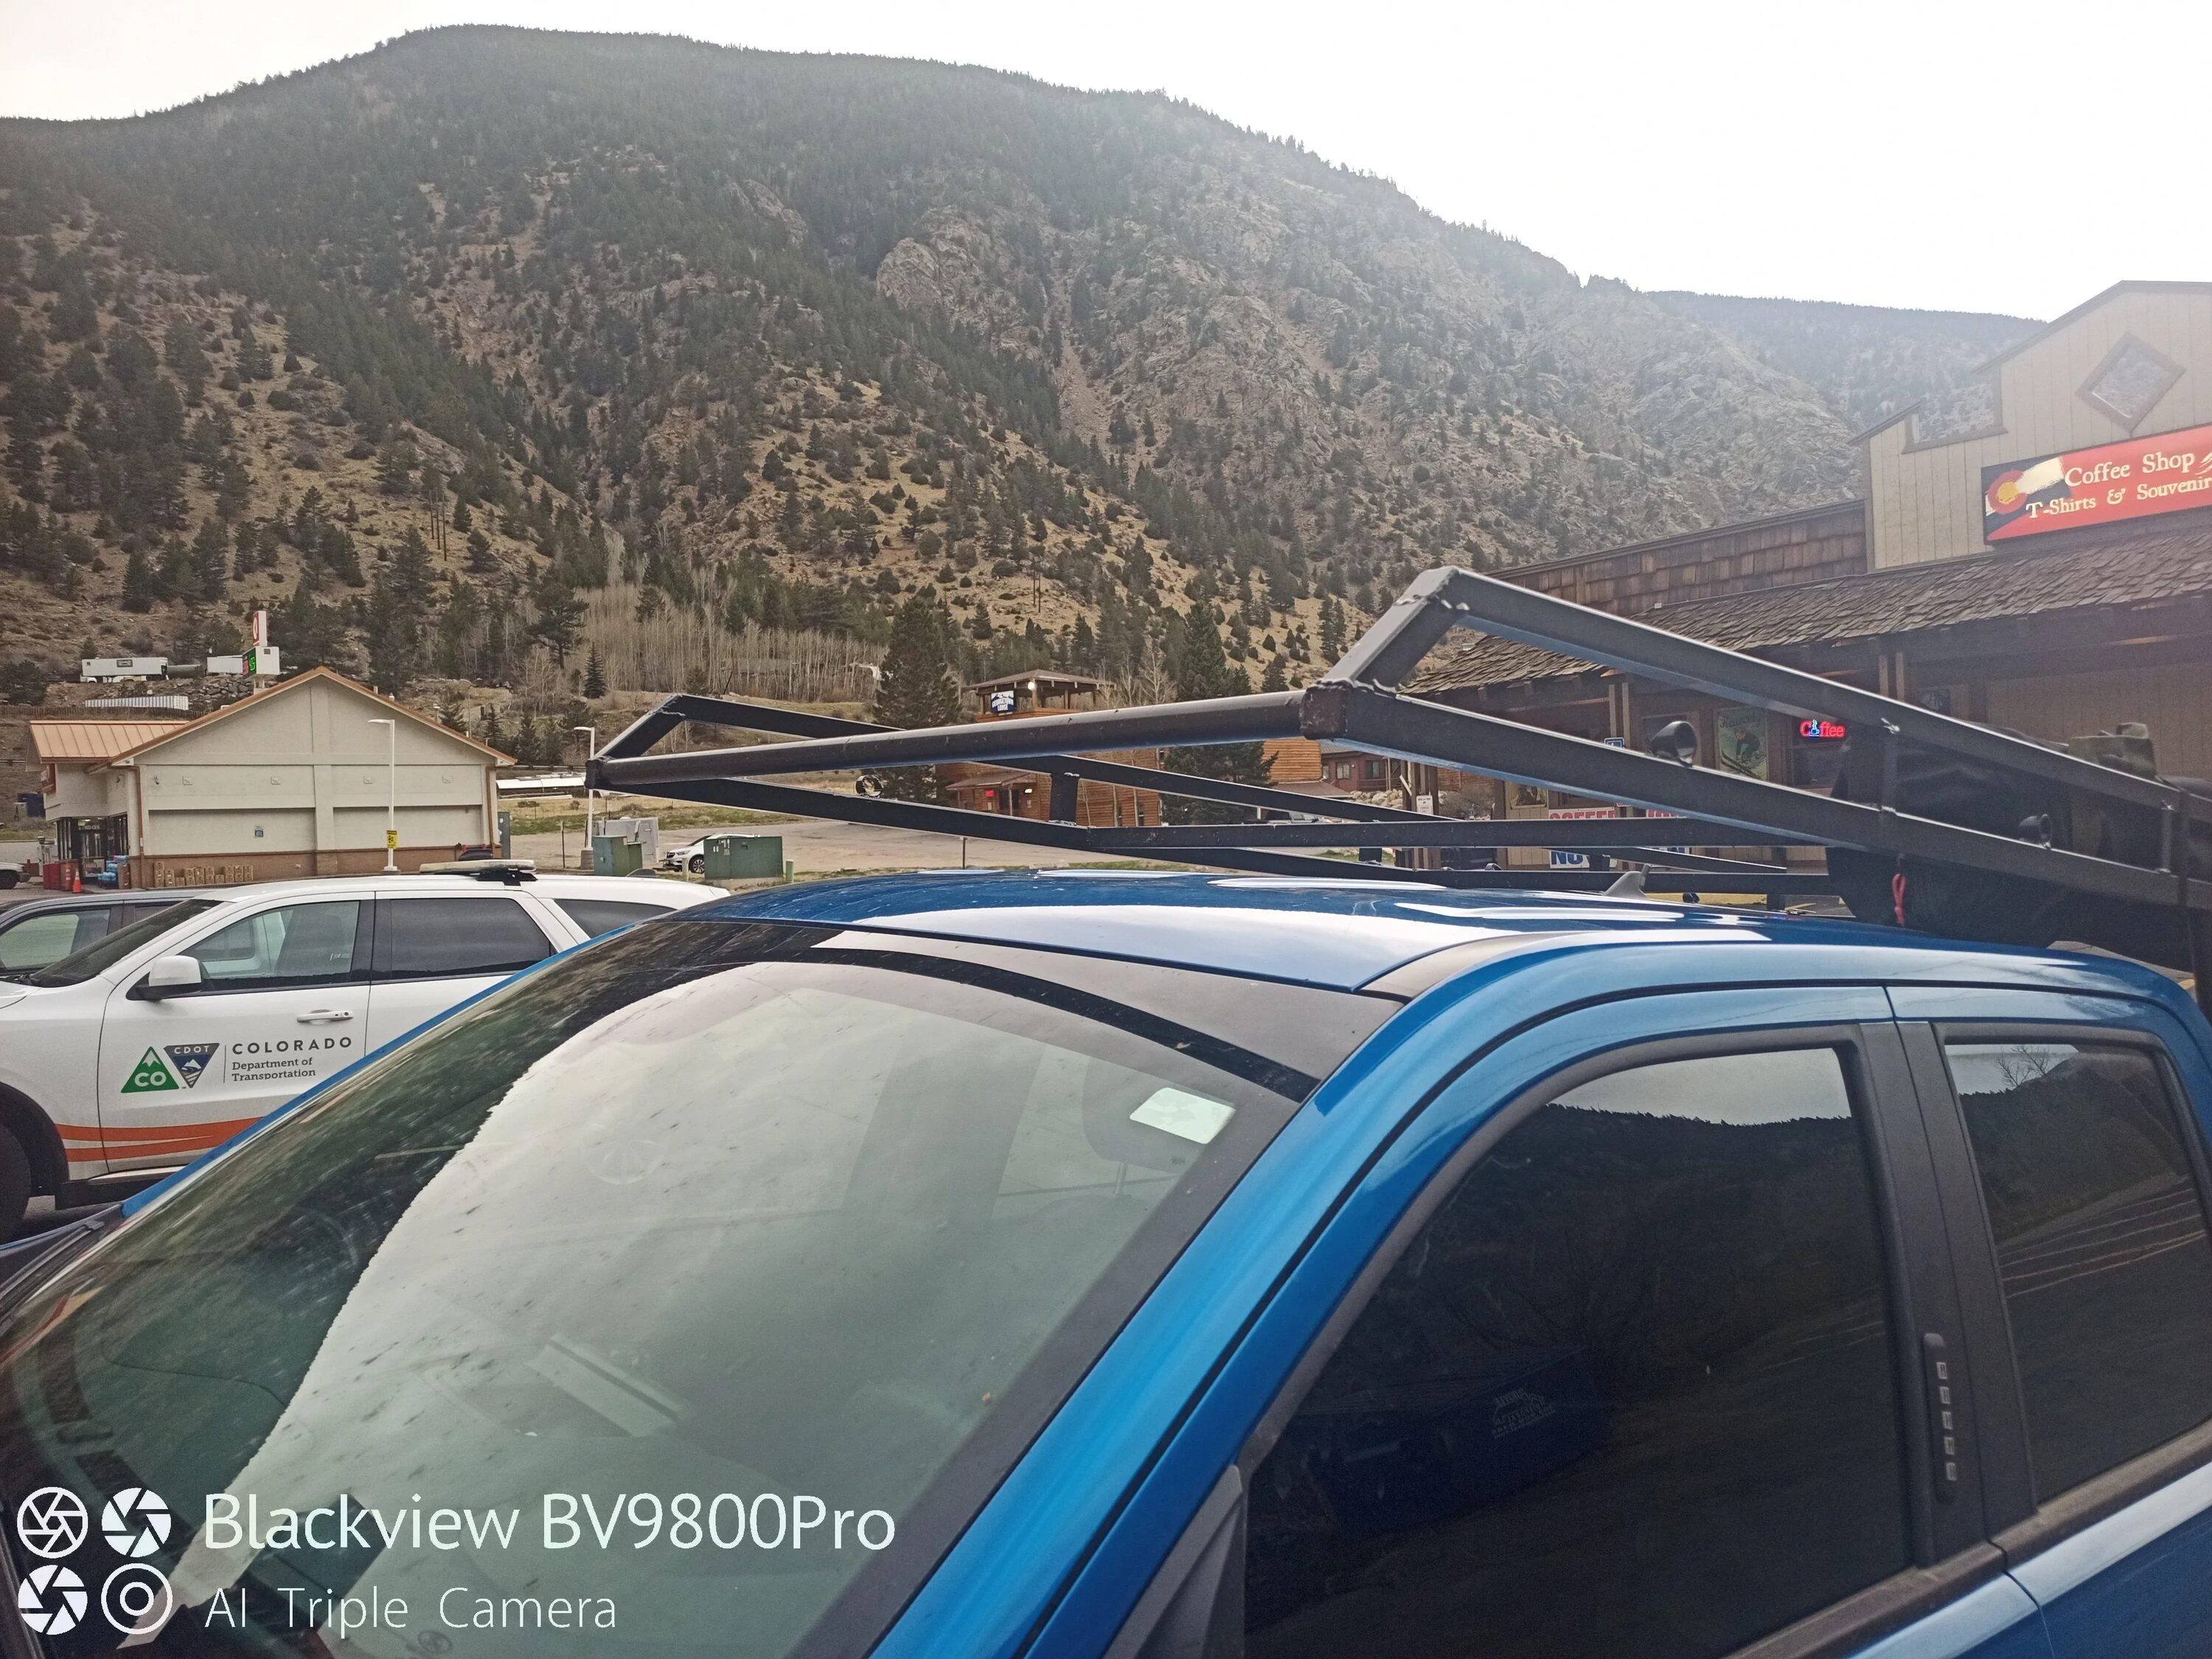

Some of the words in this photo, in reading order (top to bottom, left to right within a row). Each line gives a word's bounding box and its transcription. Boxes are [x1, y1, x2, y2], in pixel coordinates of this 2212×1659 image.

[2065, 462, 2130, 487] Coffee
[2142, 451, 2195, 474] Shop
[2025, 496, 2096, 519] T-Shirts
[2107, 487, 2126, 505] &
[174, 1045, 209, 1054] CDOT
[232, 1037, 352, 1055] COLORADO
[232, 1058, 298, 1071] Department
[302, 1057, 313, 1066] of
[134, 1071, 167, 1088] CO
[232, 1068, 316, 1082] Transportation
